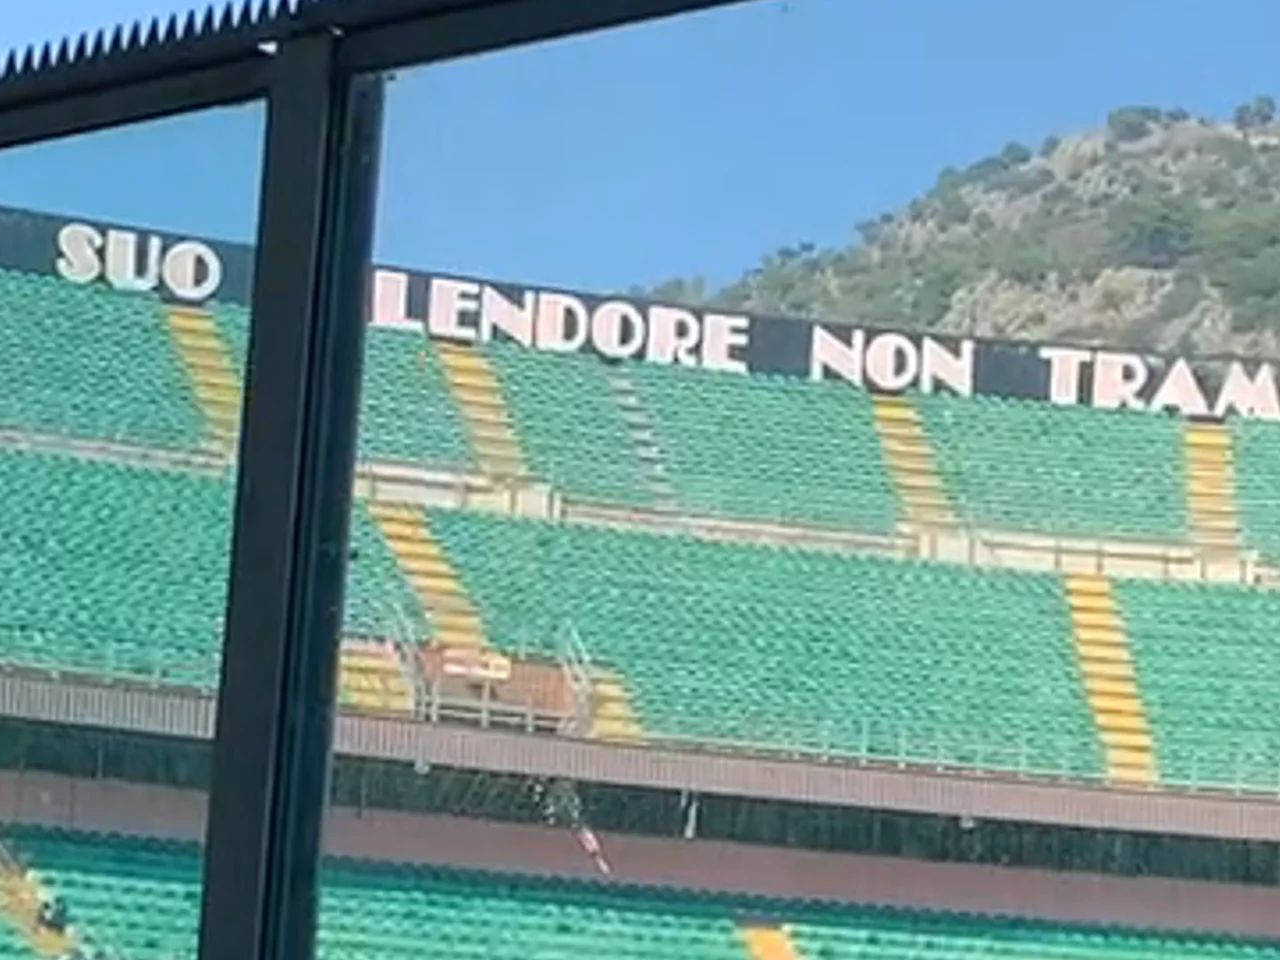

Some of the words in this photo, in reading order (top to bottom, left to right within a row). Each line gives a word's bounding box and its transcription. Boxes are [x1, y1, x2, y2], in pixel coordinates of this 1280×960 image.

[56, 222, 223, 300] SUO
[367, 269, 751, 374] LENDORE
[810, 324, 975, 397] NON
